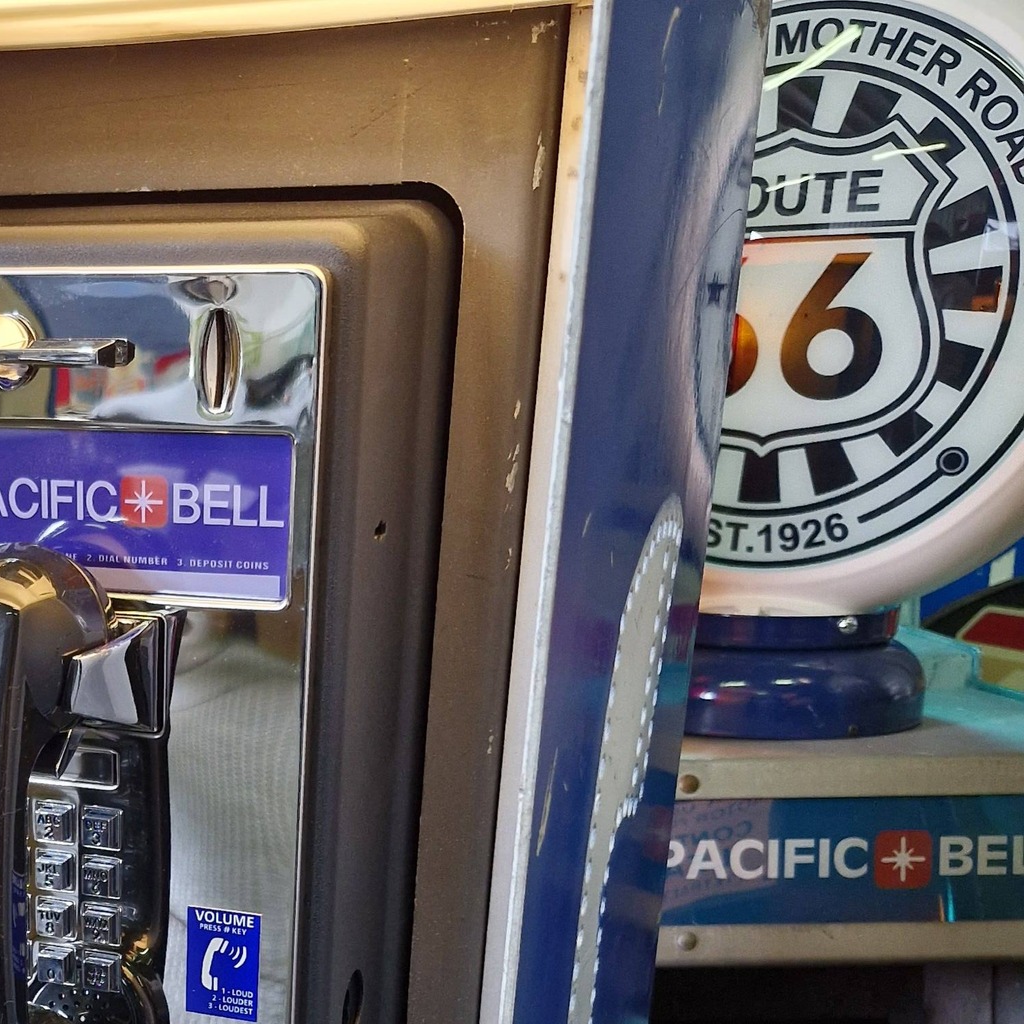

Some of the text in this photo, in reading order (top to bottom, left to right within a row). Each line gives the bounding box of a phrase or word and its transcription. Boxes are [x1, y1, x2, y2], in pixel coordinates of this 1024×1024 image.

[776, 18, 961, 86] MOTHER
[172, 482, 285, 529] BELL
[98, 555, 121, 564] DIAL
[123, 555, 168, 566] NUMBER
[177, 558, 269, 570] 3. DEPOSIT COINS
[37, 814, 61, 827] ABC
[43, 826, 54, 840] 2
[37, 863, 60, 877] JKL
[39, 910, 61, 923] TUV
[194, 909, 255, 929] VOLUME
[45, 921, 55, 936] 8
[199, 922, 221, 932] PRESS
[231, 927, 247, 936] KEY
[231, 989, 254, 999] LOUD
[222, 996, 253, 1007] LOUDER
[218, 1004, 253, 1016] LOUDEST
